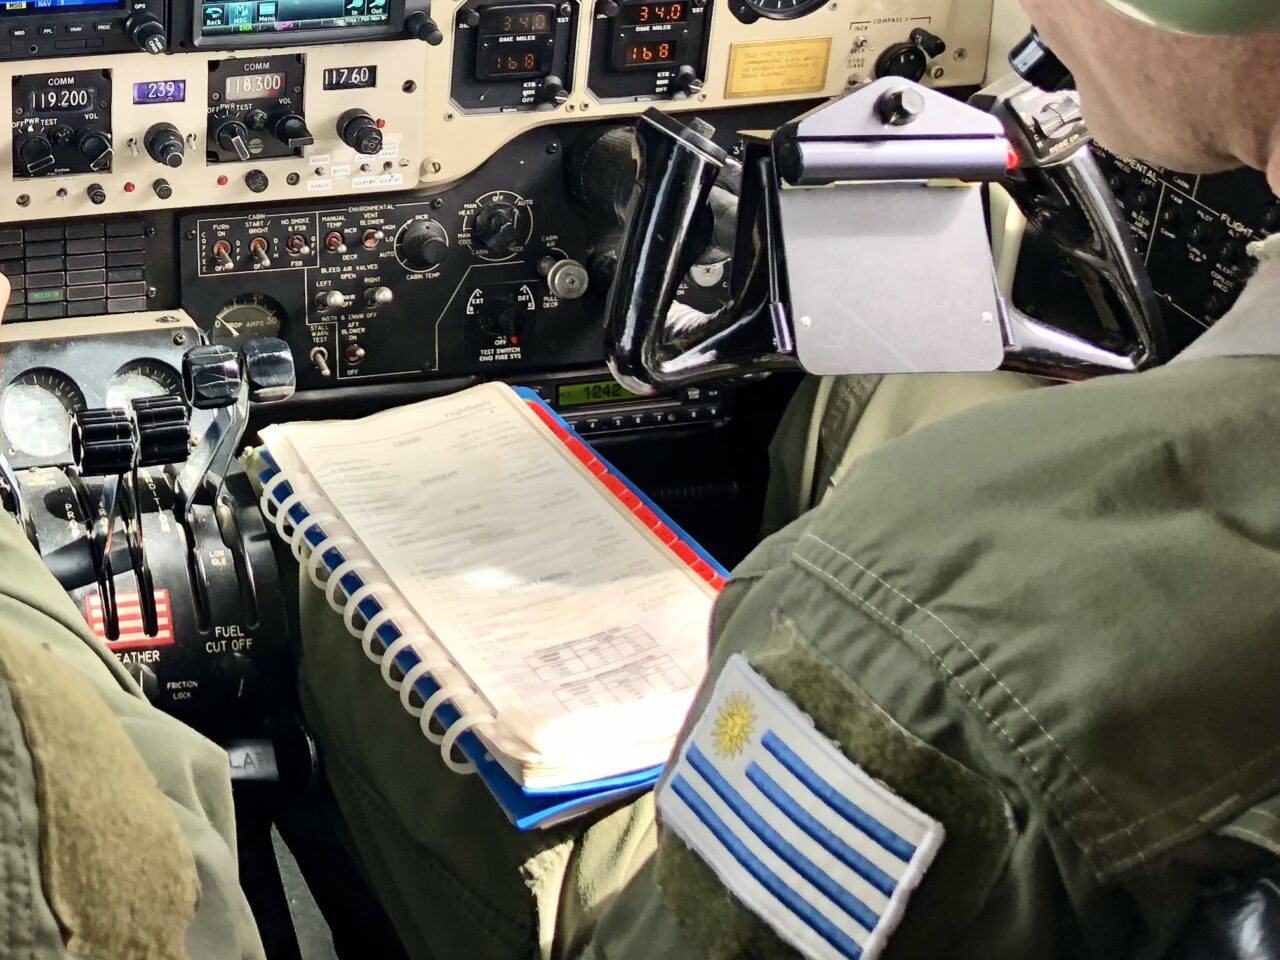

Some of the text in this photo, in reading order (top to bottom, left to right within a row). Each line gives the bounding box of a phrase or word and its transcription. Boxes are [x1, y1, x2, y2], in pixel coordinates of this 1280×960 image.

[206, 18, 221, 26] Back
[631, 43, 669, 60] 168
[243, 62, 270, 71] COMM
[324, 67, 369, 85] 117.60
[48, 76, 75, 86] COMM
[226, 75, 281, 93] 118.300
[148, 82, 175, 98] 239
[32, 90, 88, 108] 119.200
[207, 102, 253, 114] OFF PWR TEST
[12, 118, 58, 129] OFF PWR TEST
[348, 204, 395, 213] ENVIRONMENTAL
[245, 220, 264, 228] START
[290, 217, 310, 225] SMOKE
[326, 221, 342, 229] TEMP
[359, 218, 384, 226] BLOWER
[1220, 213, 1254, 238] FLIGHT
[342, 253, 358, 261] DECR
[320, 266, 339, 274] BLEED
[355, 264, 378, 272] VALVES
[340, 272, 356, 280] OPEN
[364, 276, 381, 284] RIGHT
[406, 273, 424, 281] CABIN
[246, 320, 264, 328] AMPS
[310, 324, 329, 332] STALL
[341, 327, 366, 335] BLOWER
[346, 368, 359, 376] OFF
[215, 625, 244, 638] FUEL
[205, 639, 253, 653] CUT OFF
[115, 650, 160, 663] EATHER
[166, 680, 198, 690] FRICTION
[173, 692, 192, 700] LOCK
